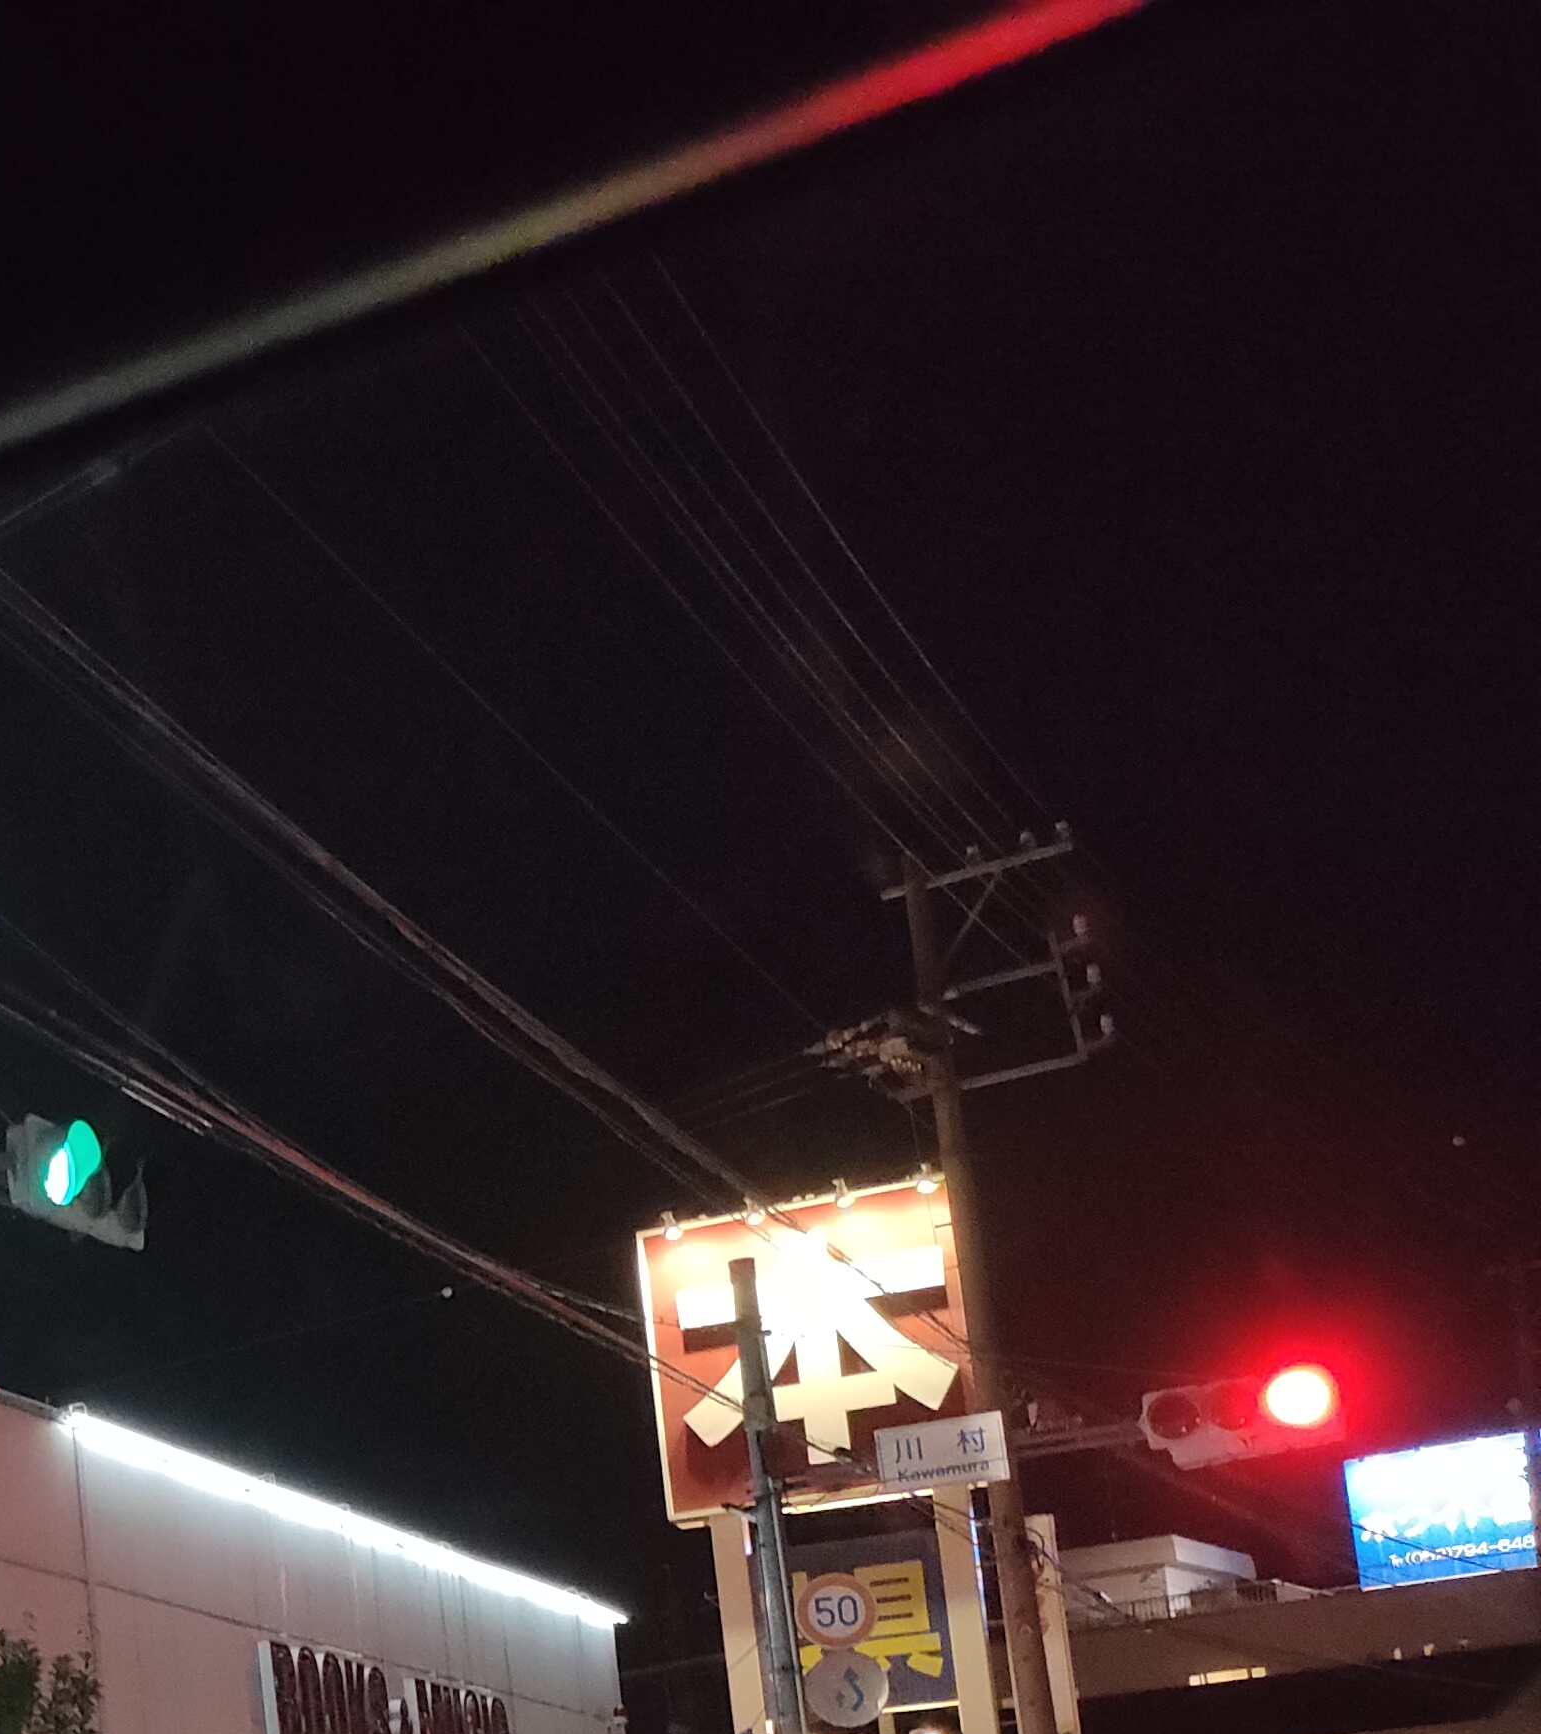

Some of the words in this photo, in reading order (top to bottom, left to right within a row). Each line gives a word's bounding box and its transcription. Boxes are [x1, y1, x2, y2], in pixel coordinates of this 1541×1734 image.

[675, 1227, 959, 1465] 本
[894, 1425, 986, 1464] 川村
[897, 1459, 990, 1483] Kawamura
[814, 1595, 859, 1628] 50
